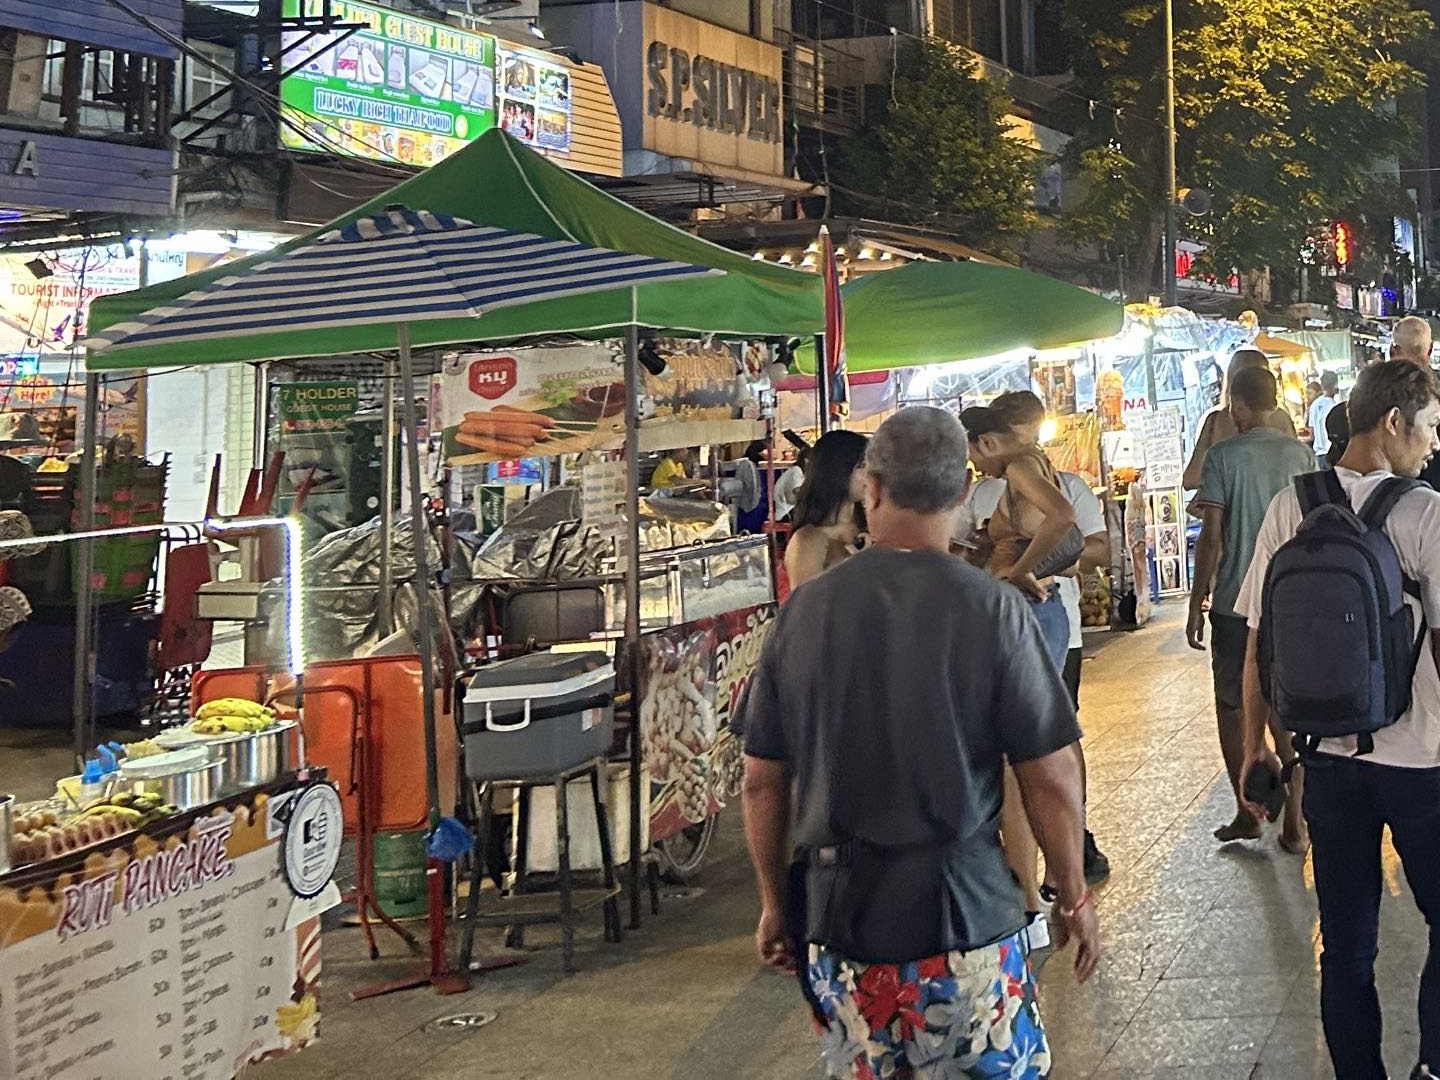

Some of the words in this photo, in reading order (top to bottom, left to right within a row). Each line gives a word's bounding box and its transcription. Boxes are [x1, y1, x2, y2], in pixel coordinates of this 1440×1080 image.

[385, 15, 434, 48] GUEST
[436, 27, 483, 58] HOUSE
[317, 91, 360, 116] LUCKY
[362, 98, 393, 121] RICH
[15, 141, 39, 176] A
[11, 283, 60, 298] TOURIST
[296, 387, 357, 400] HOLDER
[321, 403, 353, 412] HOUSE
[1063, 422, 1084, 434] juice
